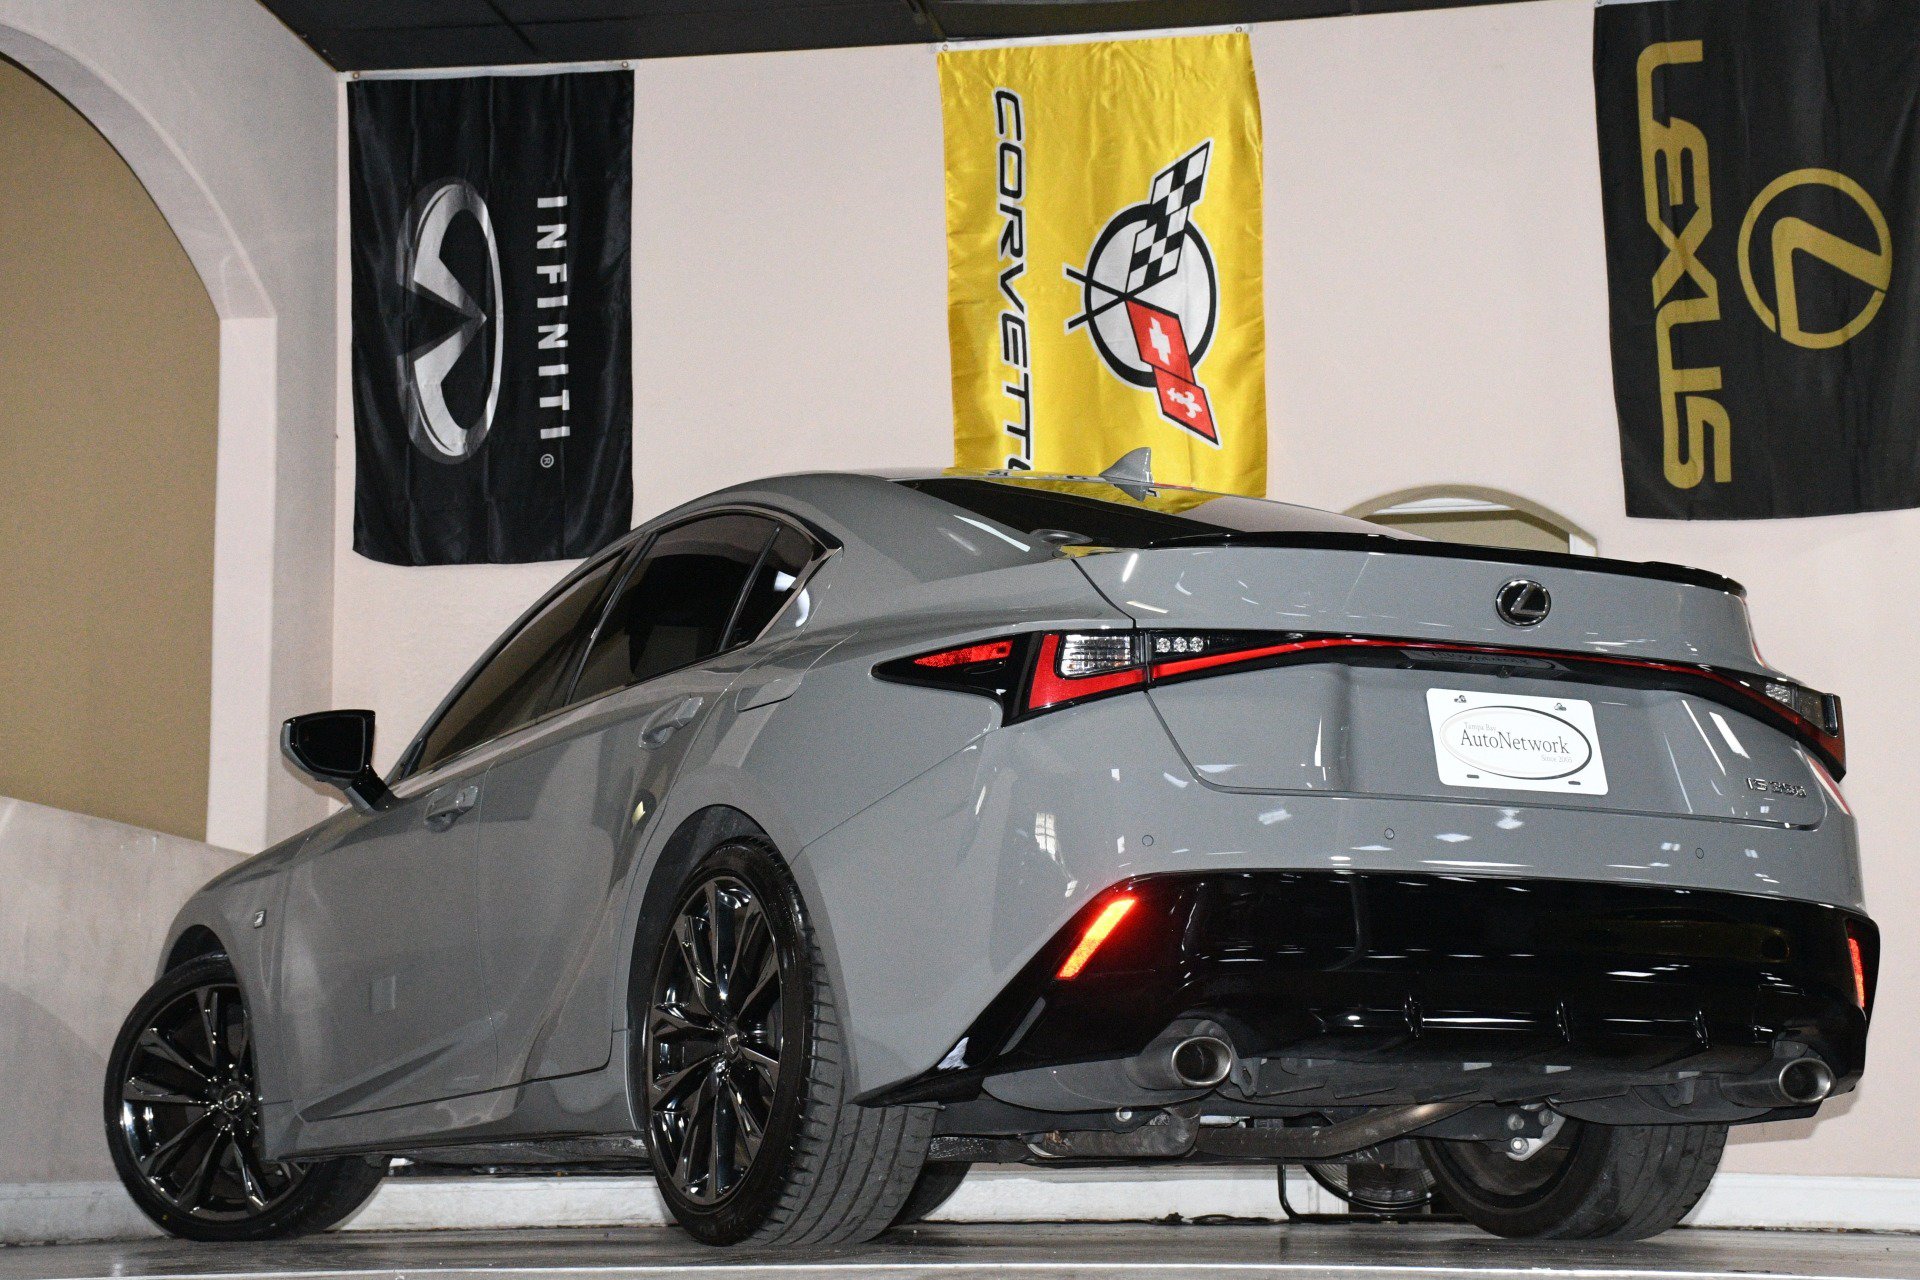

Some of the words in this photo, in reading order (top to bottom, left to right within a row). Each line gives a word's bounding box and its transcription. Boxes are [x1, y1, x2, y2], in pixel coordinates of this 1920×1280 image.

[536, 195, 571, 439] INFINITI
[1636, 39, 1731, 490] LEXUS
[1460, 728, 1570, 754] AutoNetwork
